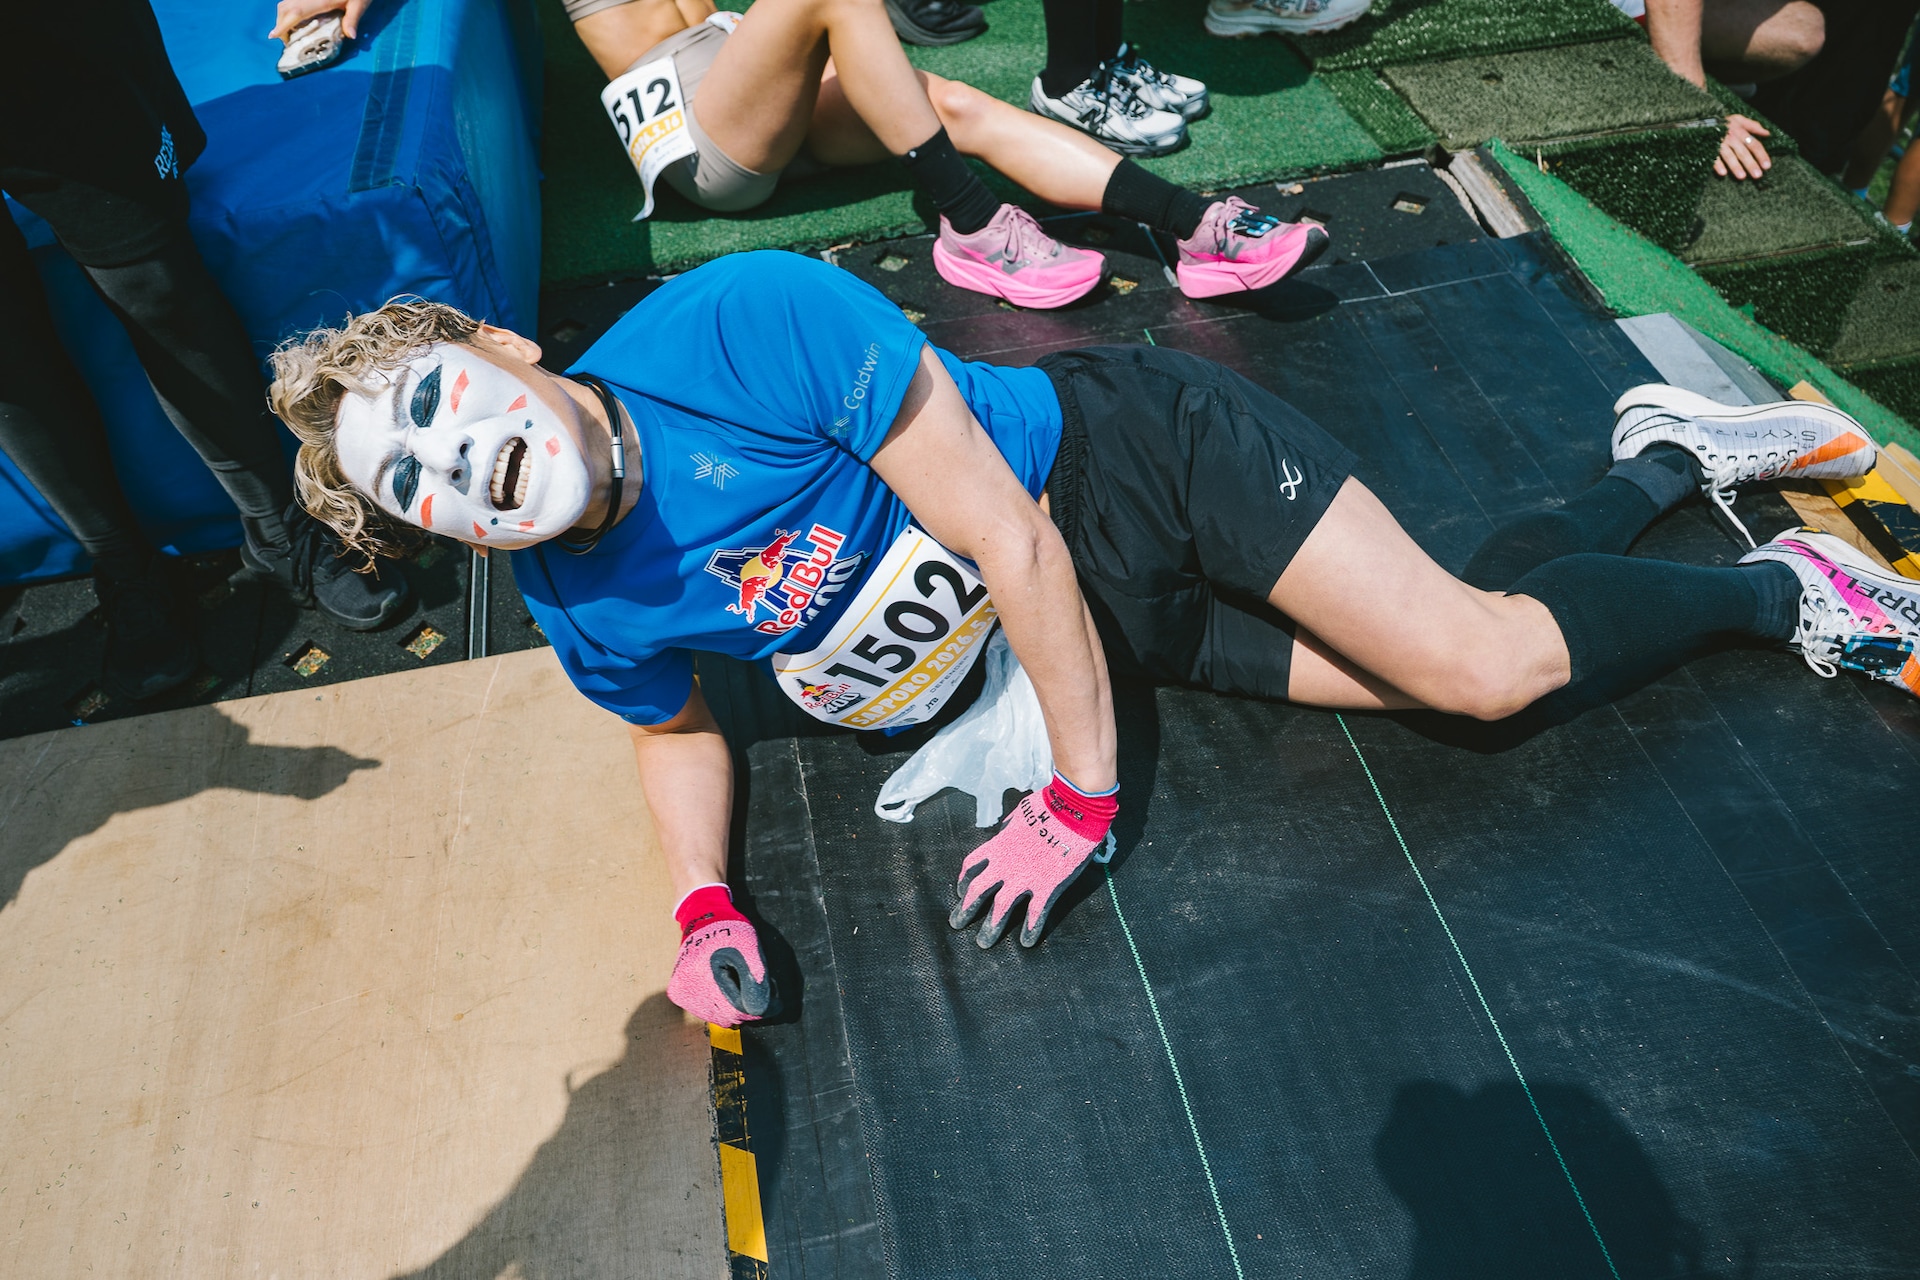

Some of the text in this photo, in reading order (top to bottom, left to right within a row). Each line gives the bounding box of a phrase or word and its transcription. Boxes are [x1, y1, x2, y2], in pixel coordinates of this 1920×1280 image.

[823, 560, 989, 688] 1502
[1819, 562, 1920, 626] RRELL
[826, 693, 860, 714] 400
[851, 606, 998, 725] SAPPORO 2026.5.1
